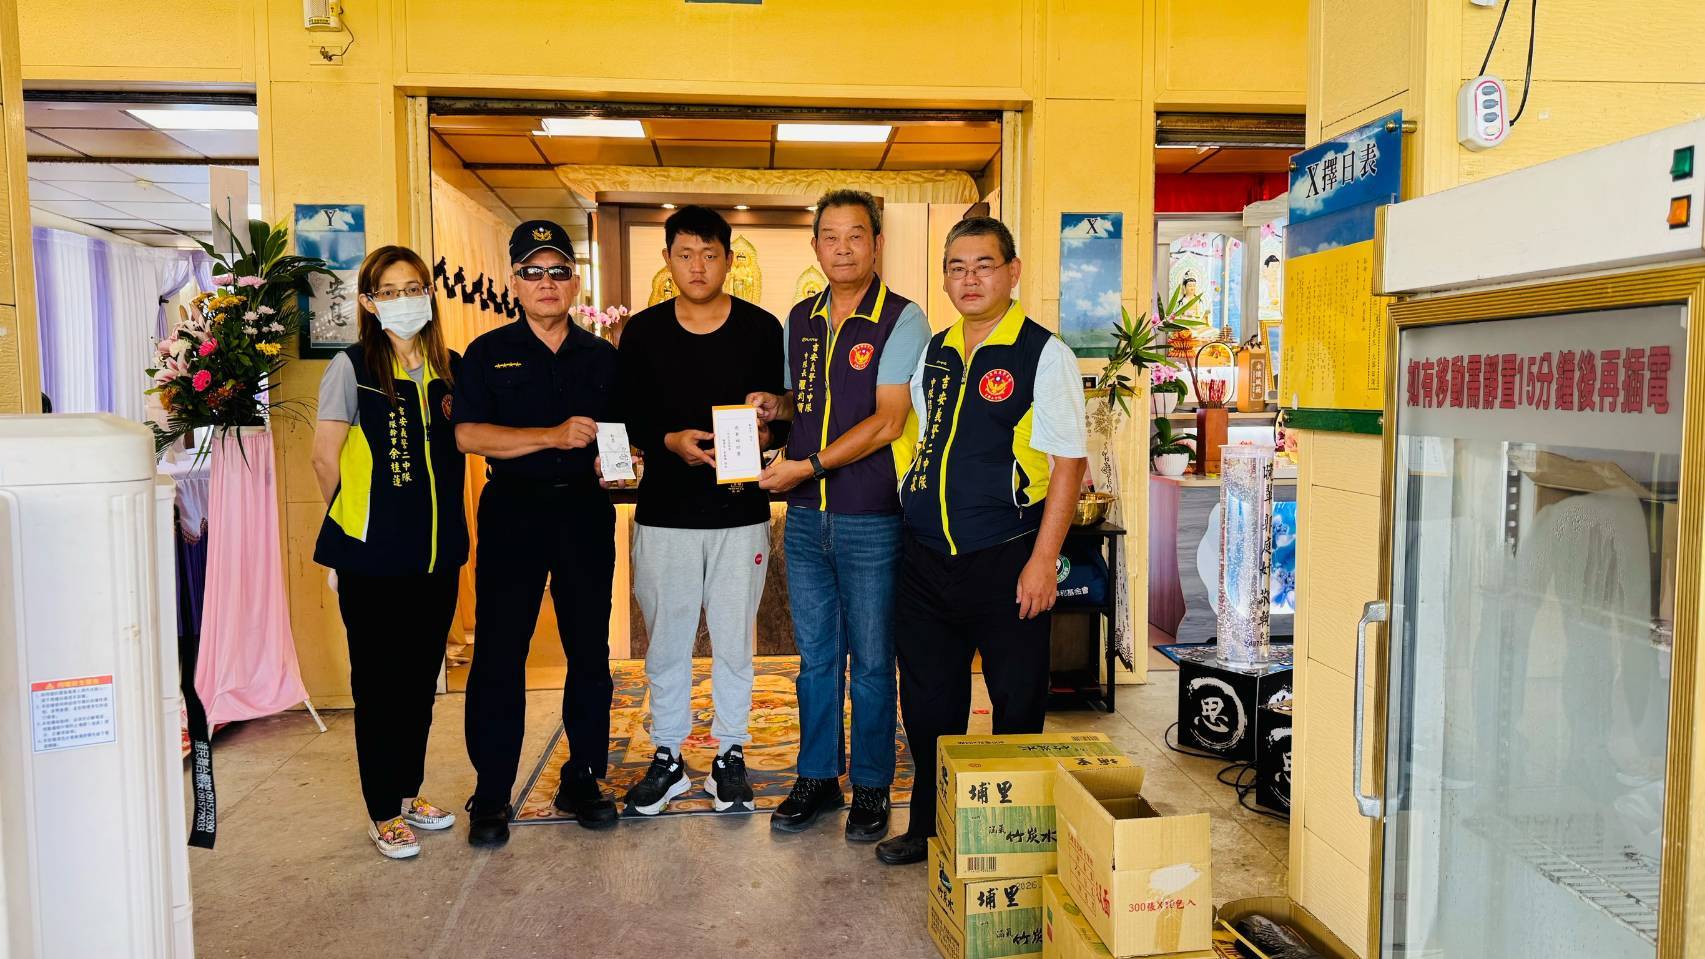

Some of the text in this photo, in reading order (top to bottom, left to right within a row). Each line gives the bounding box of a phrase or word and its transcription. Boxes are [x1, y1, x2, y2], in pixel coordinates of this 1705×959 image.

[1305, 143, 1377, 198] X擇日表
[324, 209, 336, 226] Y
[1086, 218, 1098, 234] X
[1407, 345, 1671, 415] 如有移動需靜置15分鐘後再插電
[1193, 696, 1230, 733] 思
[969, 781, 1012, 804] 埔里
[1006, 828, 1056, 844] 竹炭水
[977, 885, 1019, 910] 埔里
